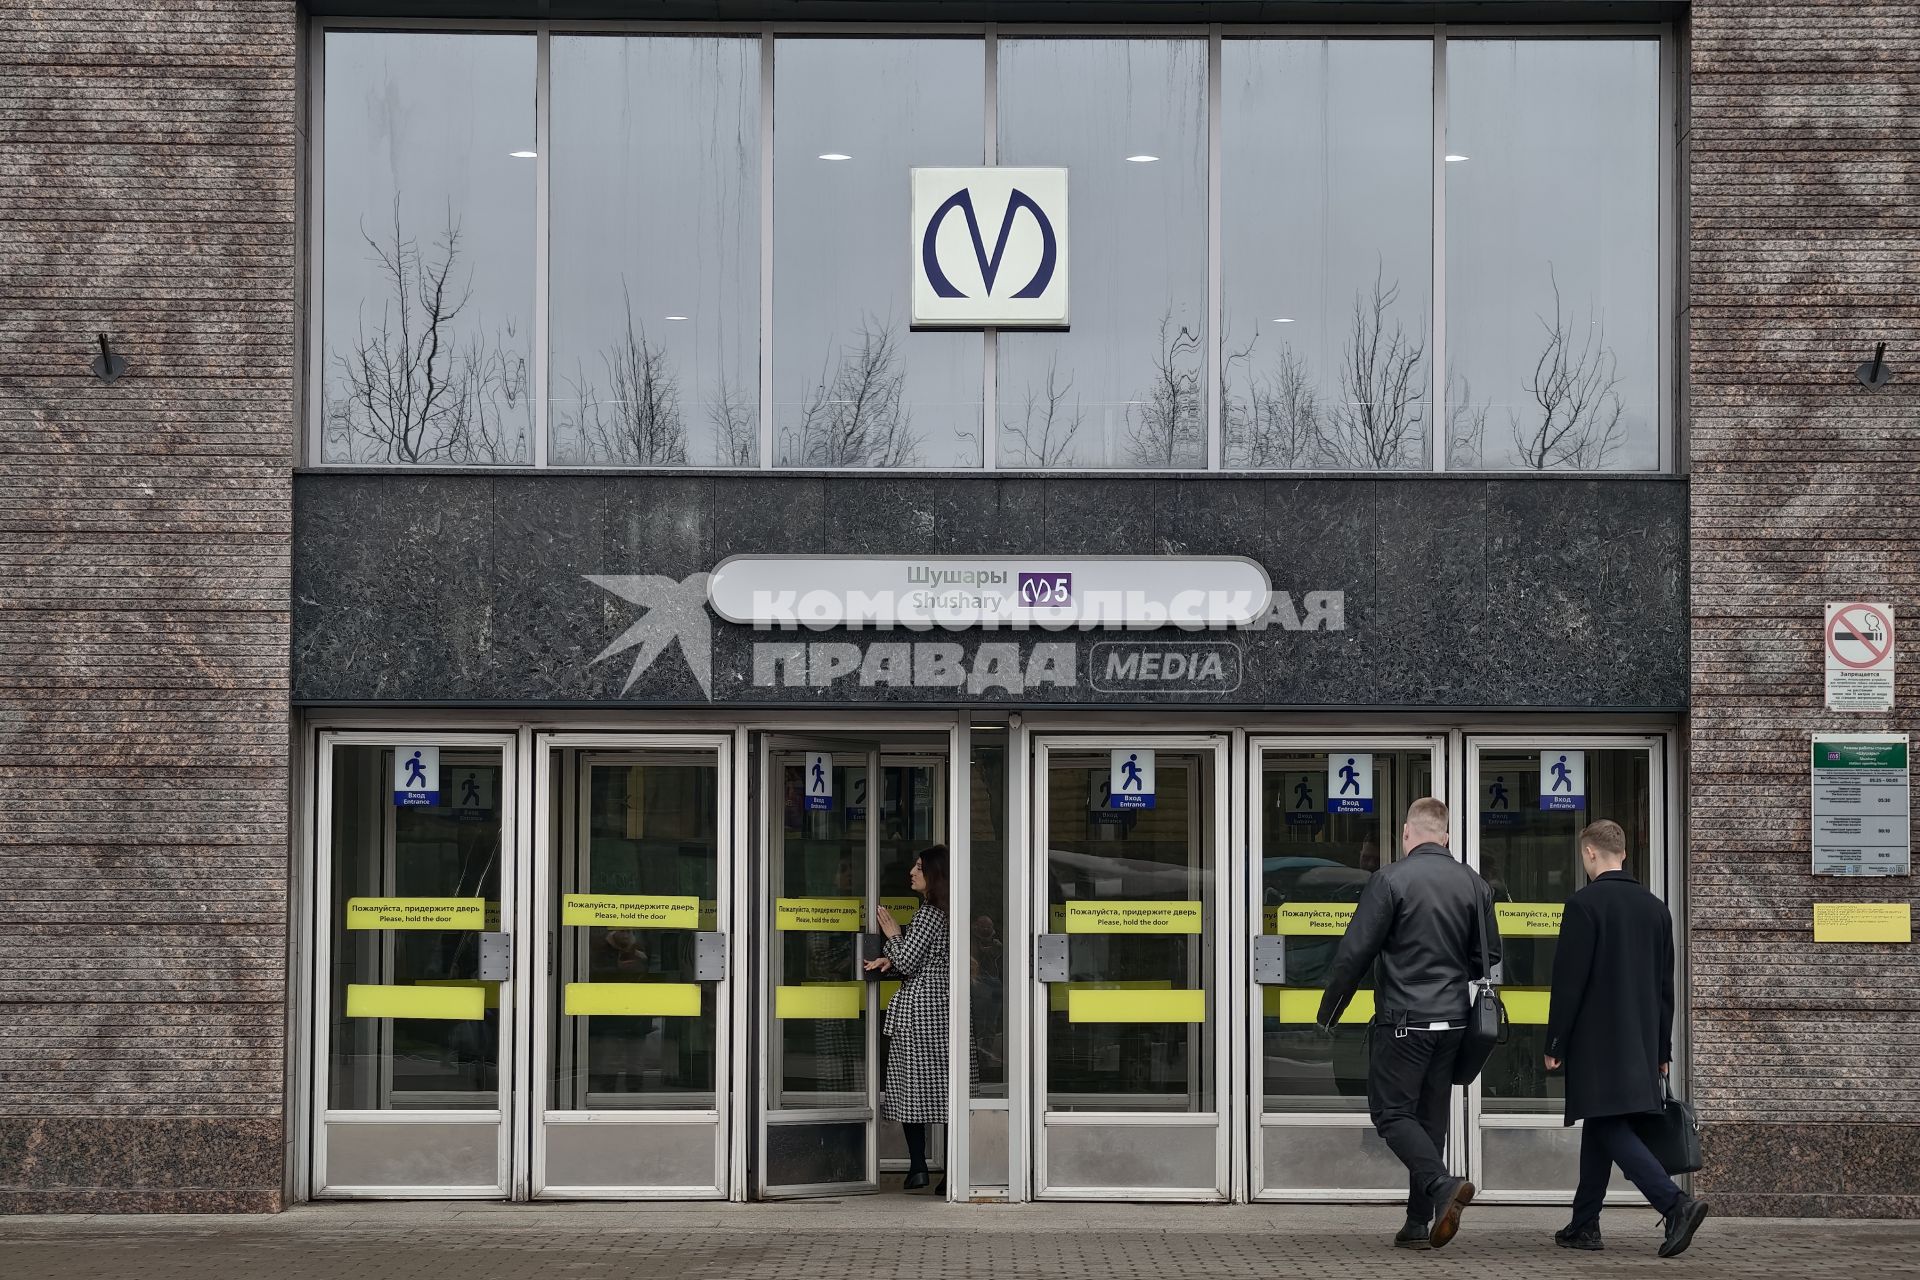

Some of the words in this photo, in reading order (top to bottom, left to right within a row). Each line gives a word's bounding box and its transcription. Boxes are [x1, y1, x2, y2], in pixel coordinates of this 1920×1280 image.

[907, 566, 1008, 588] Шушары
[1054, 578, 1068, 603] 5
[912, 592, 1002, 612] Shushary
[351, 904, 403, 914] Пожалуйста,
[404, 906, 455, 914] придержите
[456, 906, 480, 914] дверь
[568, 901, 618, 910] Пожалуйста,
[619, 903, 670, 911] придержите
[671, 904, 695, 912] дверь
[778, 905, 810, 914] Пожалуйста,
[811, 907, 842, 915] придержите
[1070, 908, 1121, 917] Пожалуйста,
[1122, 909, 1172, 917] придержите
[1173, 909, 1197, 917] дверь
[1282, 910, 1333, 919] Пожалуйста,
[1499, 910, 1550, 919] Пожалуйста,
